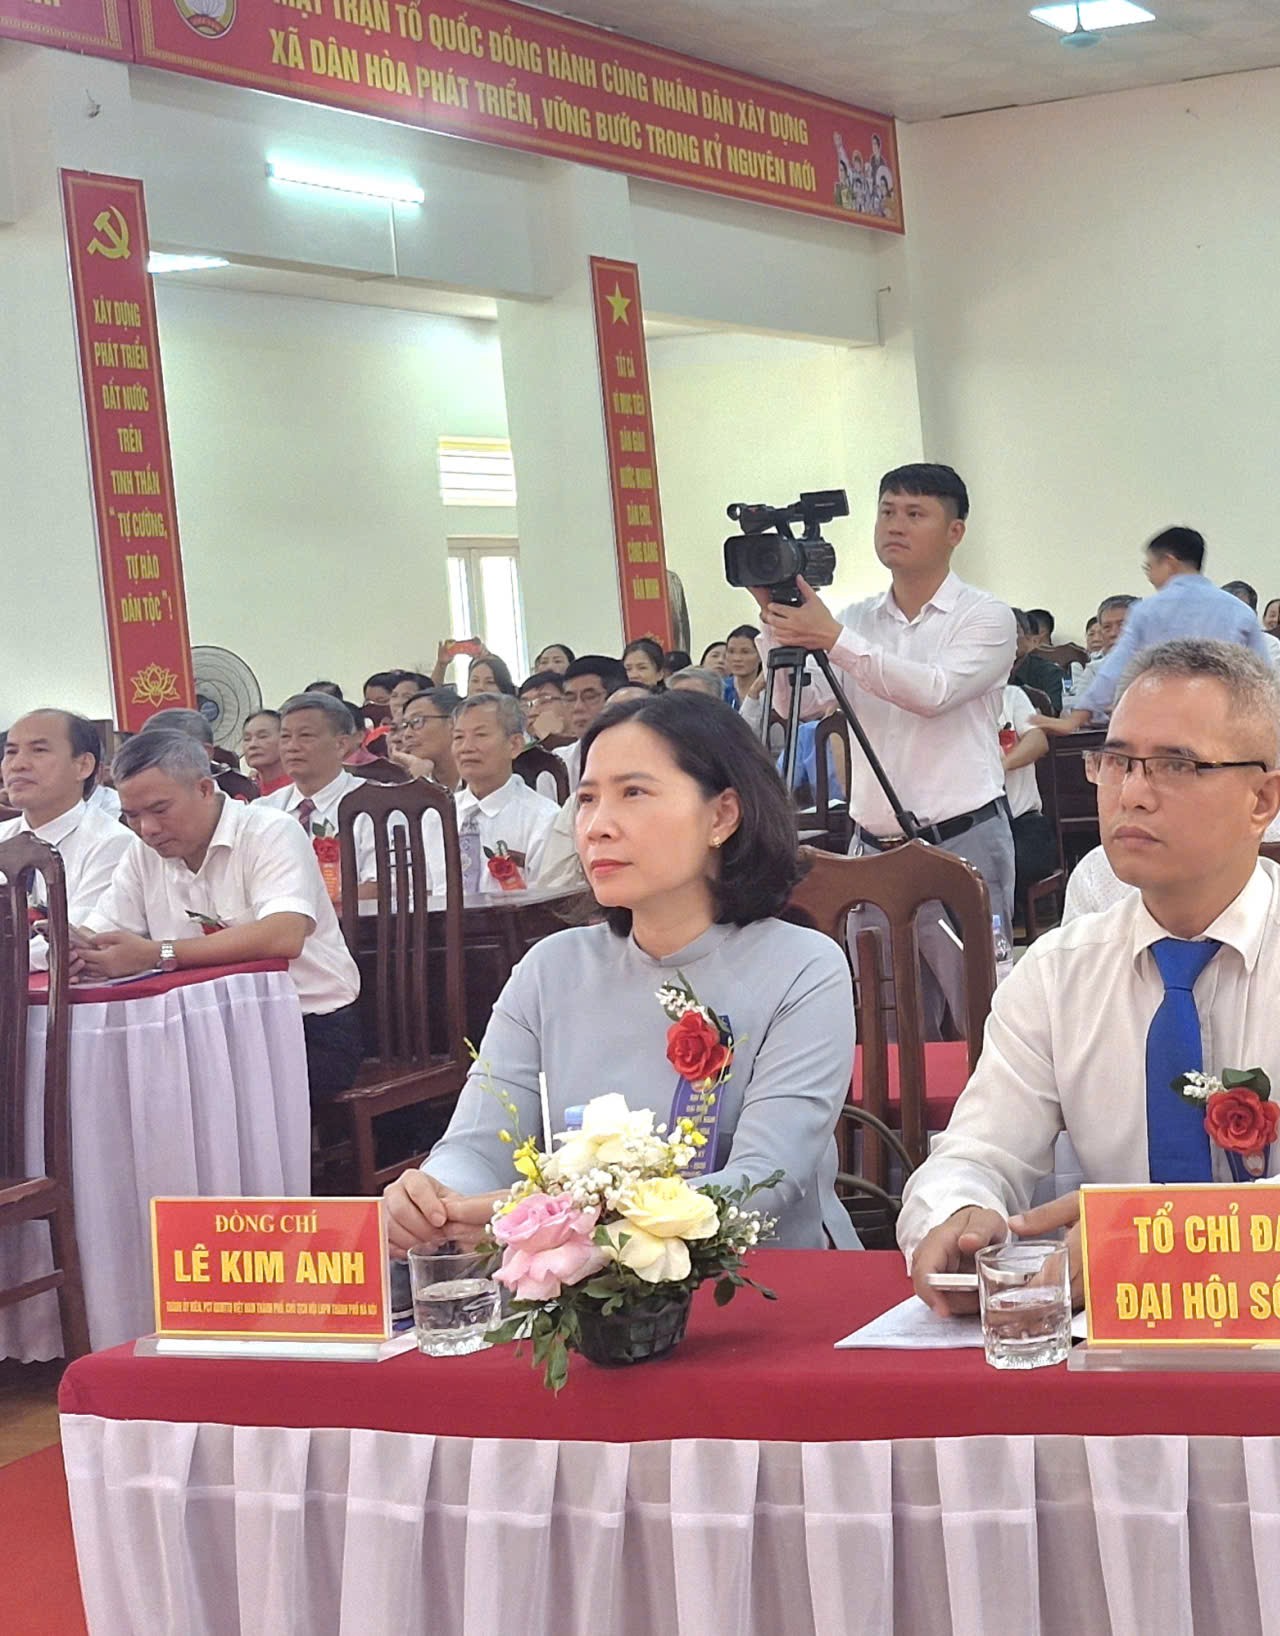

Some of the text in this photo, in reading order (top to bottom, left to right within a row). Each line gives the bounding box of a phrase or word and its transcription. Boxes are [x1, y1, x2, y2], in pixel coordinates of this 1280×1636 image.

[396, 0, 423, 41] TỔ
[429, 11, 484, 58] QUỐC
[488, 24, 543, 74] ĐỒNG
[546, 45, 597, 88] HÀNH
[601, 59, 648, 102] CÙNG
[652, 77, 698, 116] NHÂN
[702, 89, 734, 126] DÂN
[738, 101, 765, 135] XÂY
[770, 113, 808, 146] DỰNG
[269, 26, 816, 192] XÃ DÂN HÒA PHÁT TRIỂN, VỮNG BƯỚC TRONG KỶ NGUYÊN MỚI
[93, 295, 112, 324] XÂY
[94, 336, 149, 370] PHÁT TRIỂN
[118, 424, 143, 453] TRÊN
[111, 470, 133, 495] TINH
[280, 1209, 318, 1233] CHÍ
[1133, 1201, 1175, 1254] TỔ
[1185, 1202, 1241, 1253] CHỈ
[174, 1243, 365, 1284] LÊ KIM ANH
[1116, 1282, 1172, 1328] ĐẠI
[1182, 1274, 1238, 1328] HỘI
